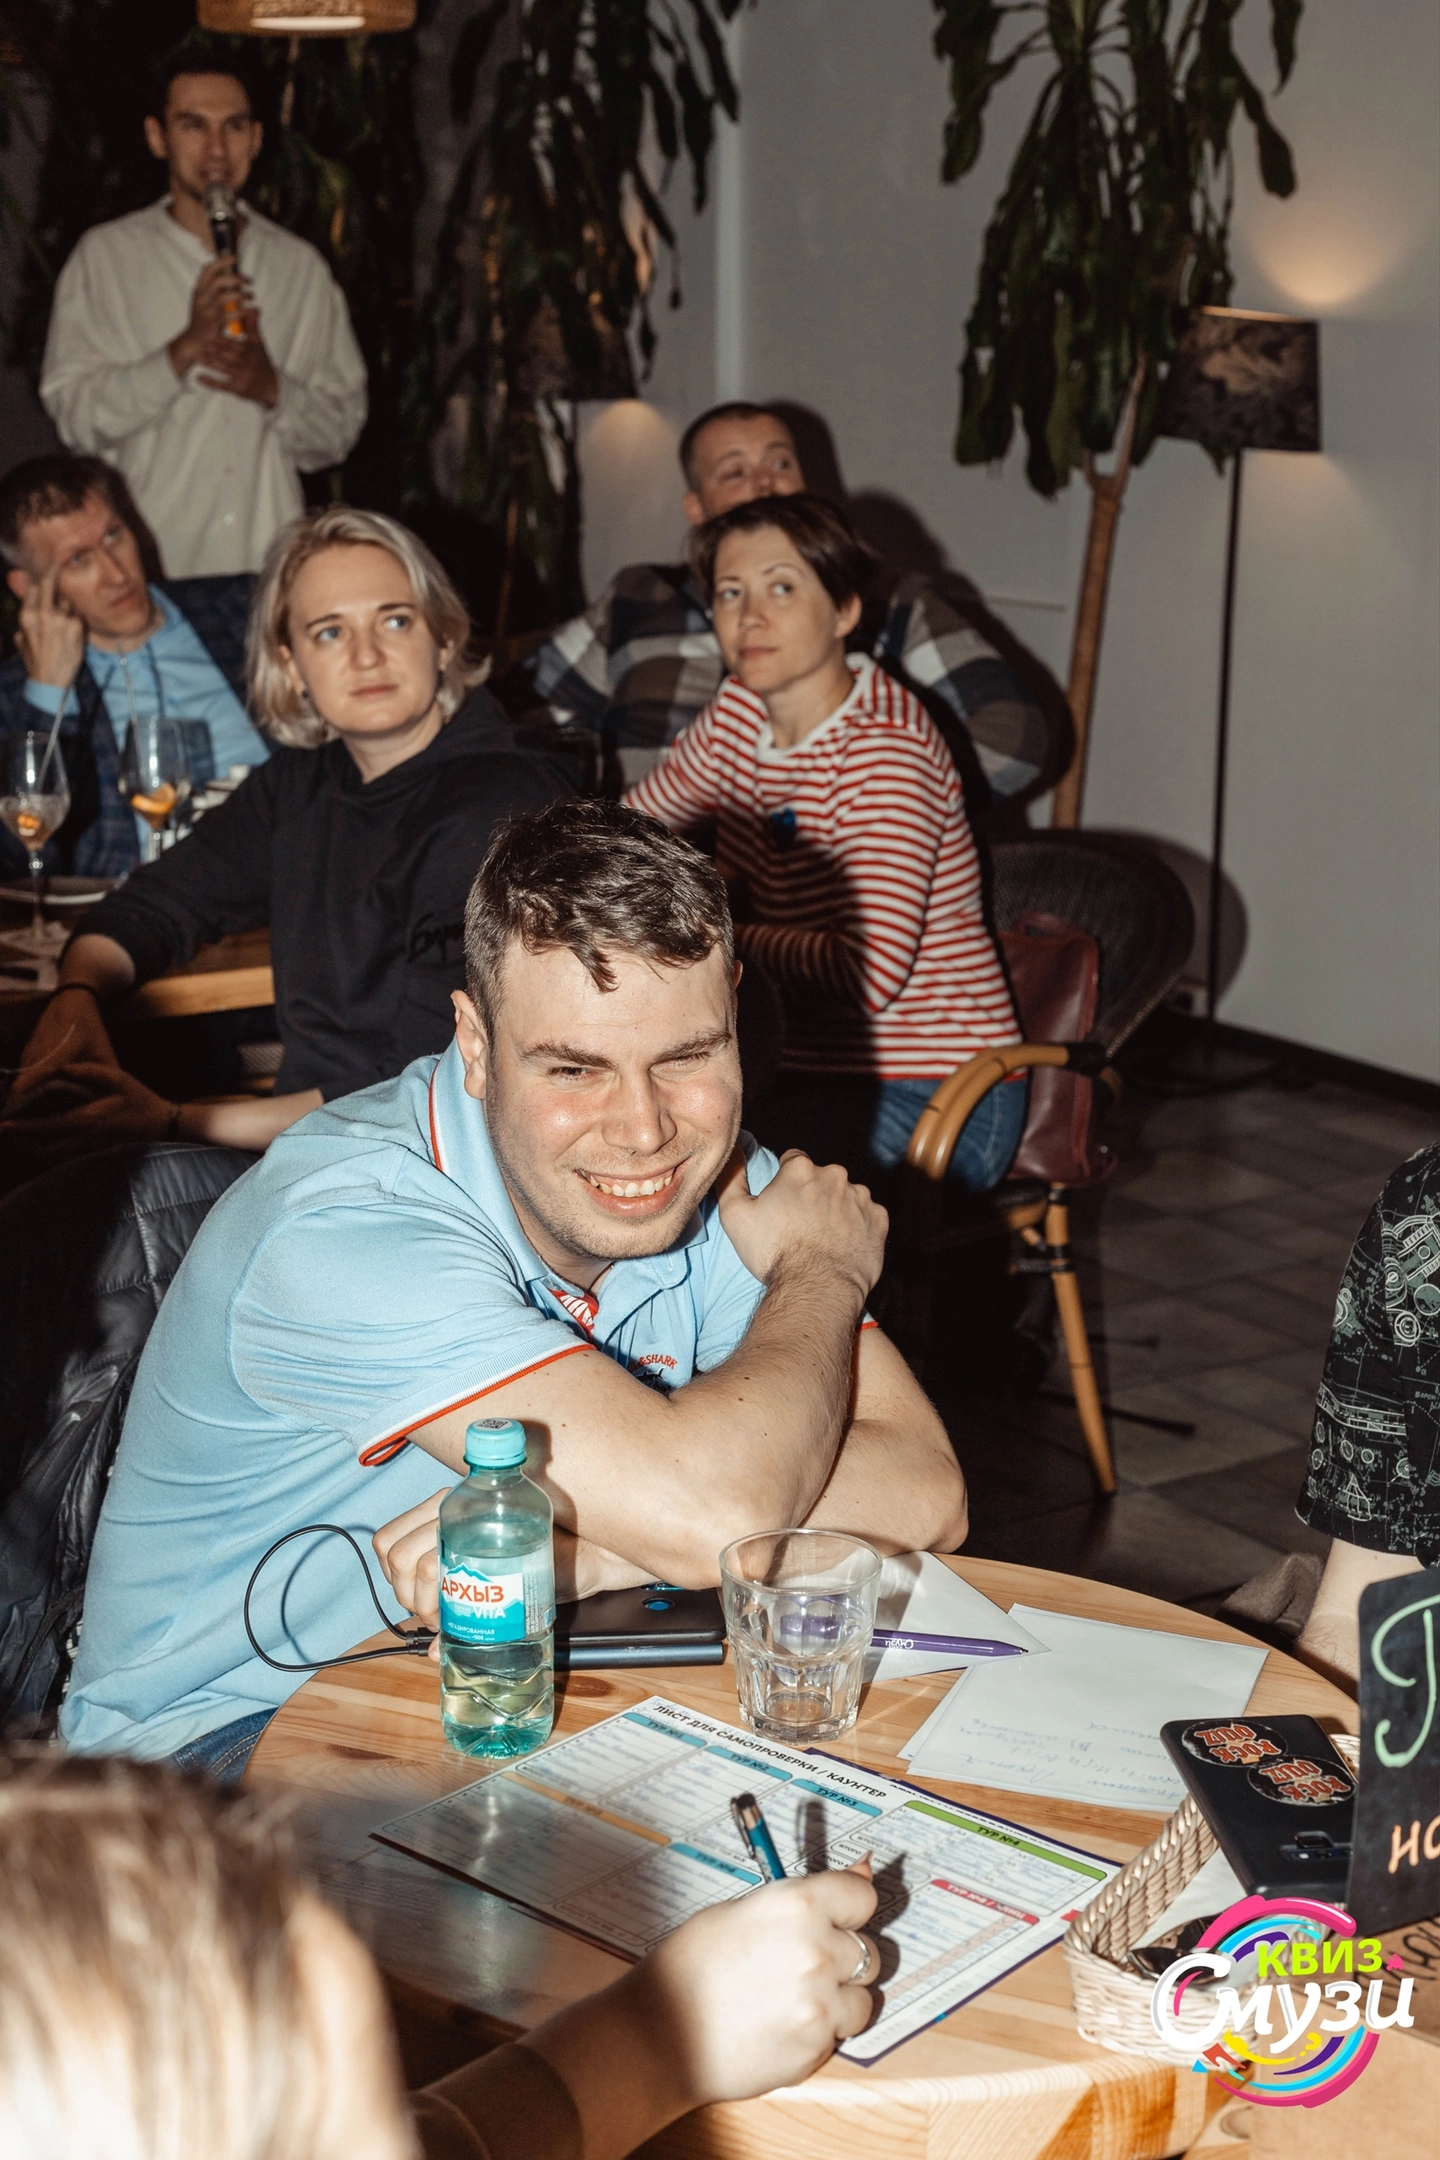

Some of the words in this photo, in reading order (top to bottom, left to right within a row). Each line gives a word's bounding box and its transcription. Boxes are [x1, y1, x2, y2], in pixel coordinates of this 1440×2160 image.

[441, 1576, 505, 1603] АРХЫЗ
[473, 1606, 507, 1619] VITA
[1194, 1723, 1257, 1746] QUIZ
[653, 1705, 691, 1722] ЛИСТ
[686, 1720, 718, 1733] ДЛЯ
[716, 1731, 818, 1772] САМОПРОВЕРКИ
[826, 1772, 887, 1798] КАУНТЕР
[1209, 1739, 1282, 1764] ROCK
[1258, 1759, 1323, 1785] QUIZ
[816, 1787, 838, 1799] ТУР
[1278, 1775, 1351, 1801] ROCK
[977, 1826, 1000, 1838] ТУР
